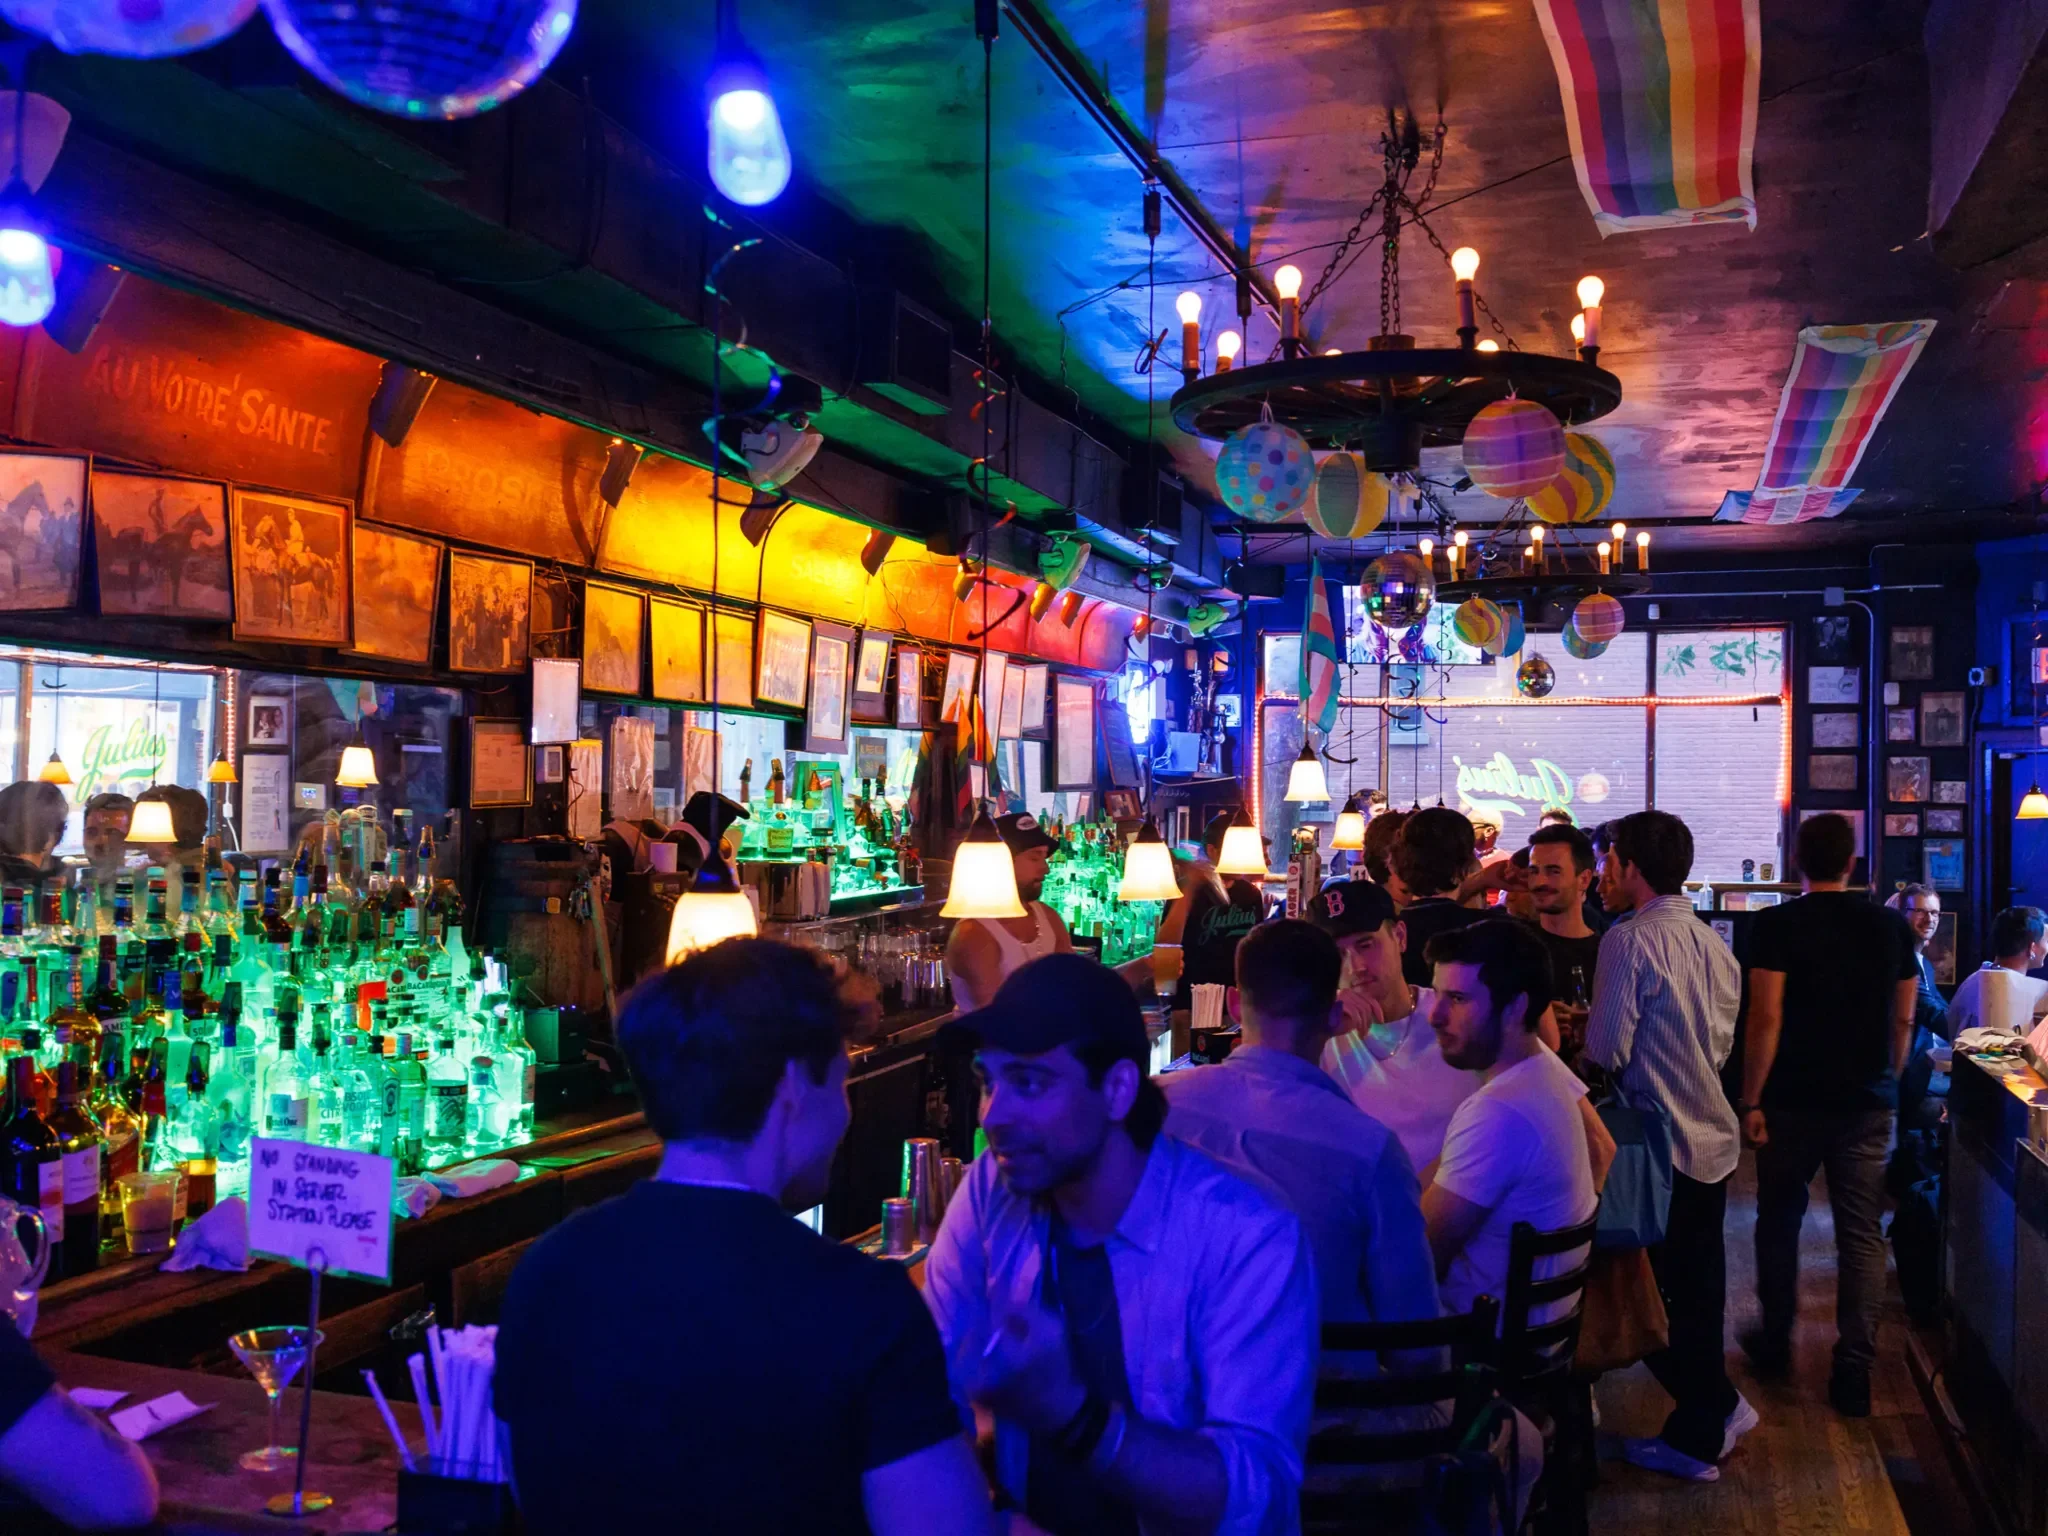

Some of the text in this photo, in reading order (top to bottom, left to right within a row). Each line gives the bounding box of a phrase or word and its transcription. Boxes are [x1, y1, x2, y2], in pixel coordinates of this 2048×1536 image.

[236, 388, 332, 455] SANTE
[1324, 889, 1346, 919] B
[260, 1149, 360, 1180] NO STANDING
[272, 1176, 347, 1201] IN SERVER
[267, 1198, 377, 1230] STATION PLEASE
